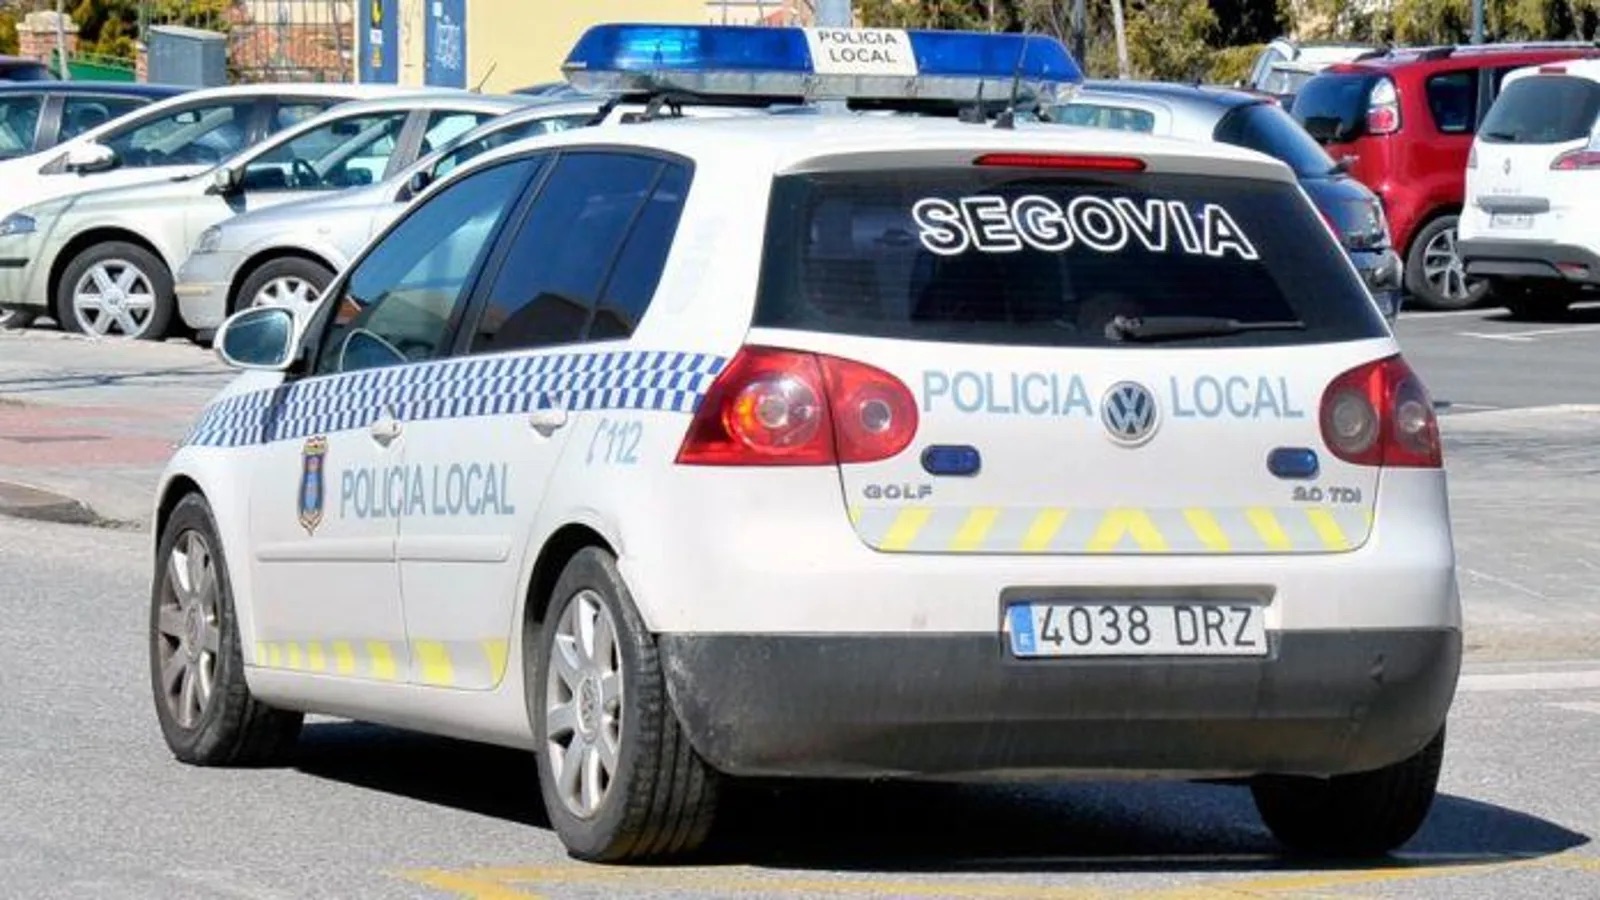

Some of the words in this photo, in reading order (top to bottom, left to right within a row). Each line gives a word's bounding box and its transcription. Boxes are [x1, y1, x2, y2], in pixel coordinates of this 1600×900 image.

[817, 31, 897, 44] POLICIA
[829, 48, 897, 62] LOCAL
[912, 195, 1259, 260] SEGOVIA
[921, 370, 1093, 417] POLICIA
[1170, 375, 1305, 419] LOCAL
[604, 420, 643, 463] 112
[339, 463, 427, 519] POLICIA
[432, 461, 516, 516] LOCAL
[863, 483, 933, 499] GOLF
[1328, 486, 1362, 503] TDI
[1040, 605, 1152, 647] 4038
[1174, 605, 1257, 647] DRZ
